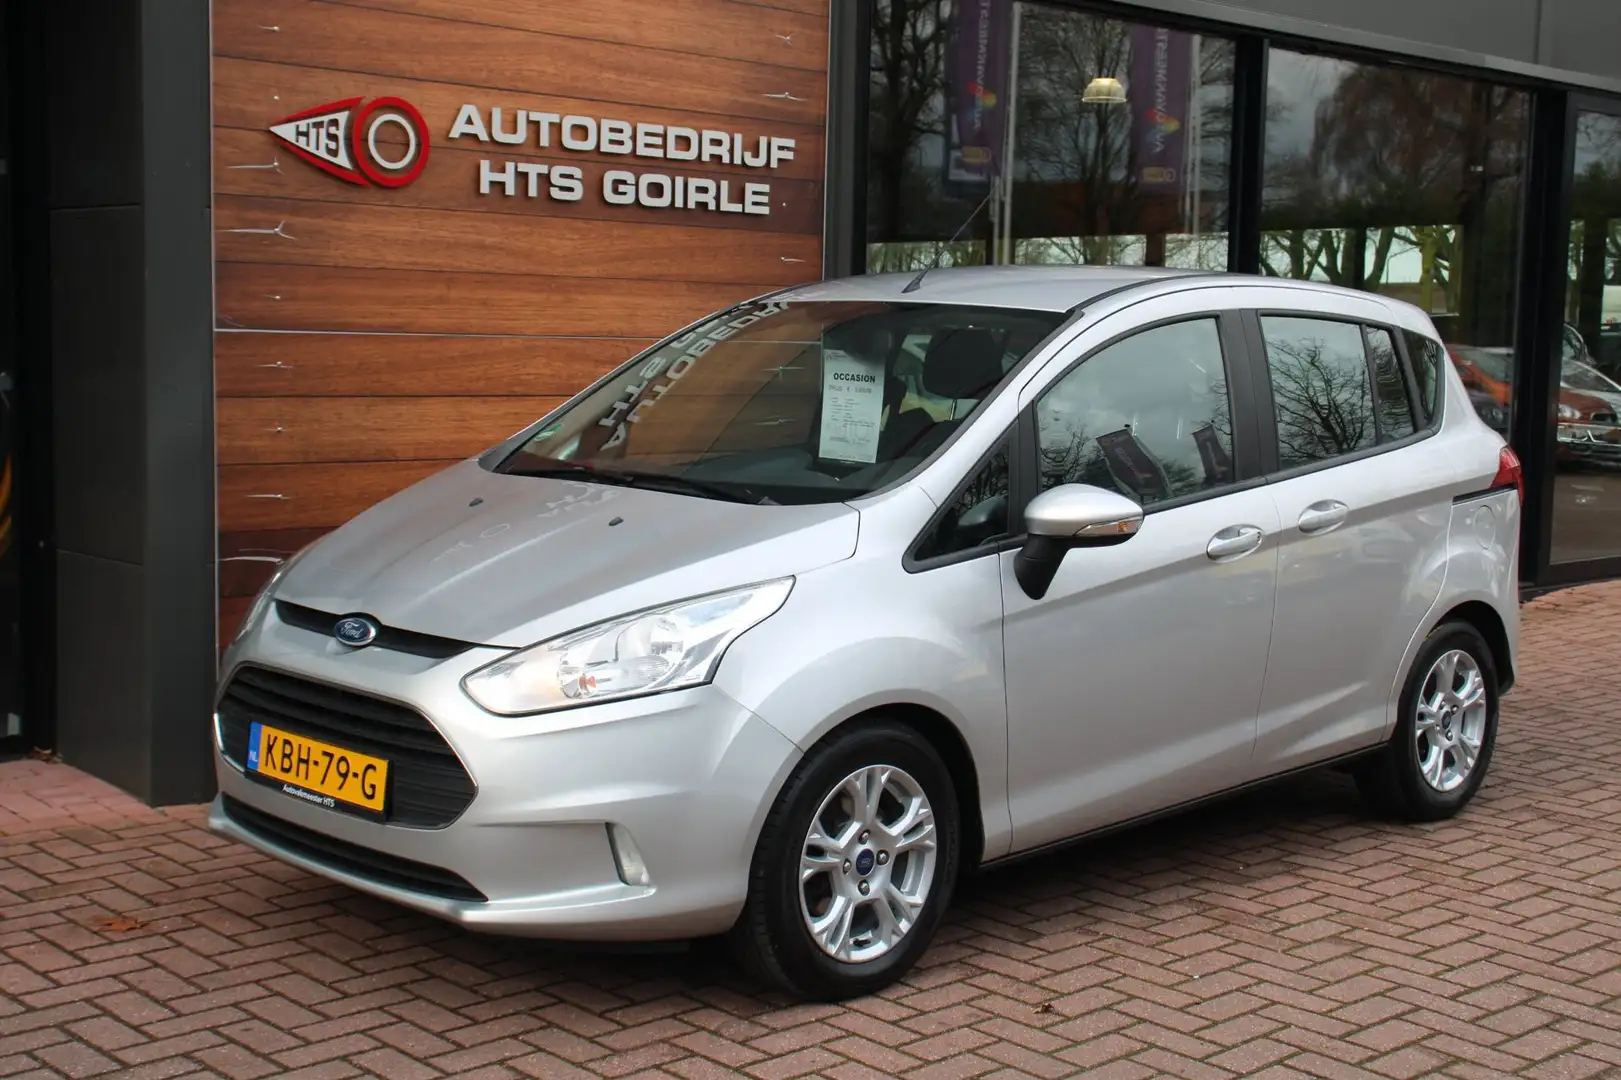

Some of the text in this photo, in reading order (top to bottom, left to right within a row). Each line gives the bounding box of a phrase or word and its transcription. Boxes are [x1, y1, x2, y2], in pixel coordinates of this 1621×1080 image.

[295, 118, 340, 158] HTS
[448, 103, 796, 169] AUTOBEDRIJF
[479, 159, 771, 215] HTS GOIRLE
[833, 372, 876, 384] OCCASION
[341, 621, 364, 638] Ford
[249, 751, 258, 763] NL
[265, 734, 377, 801] KBH-79-G
[323, 797, 335, 808] HTS
